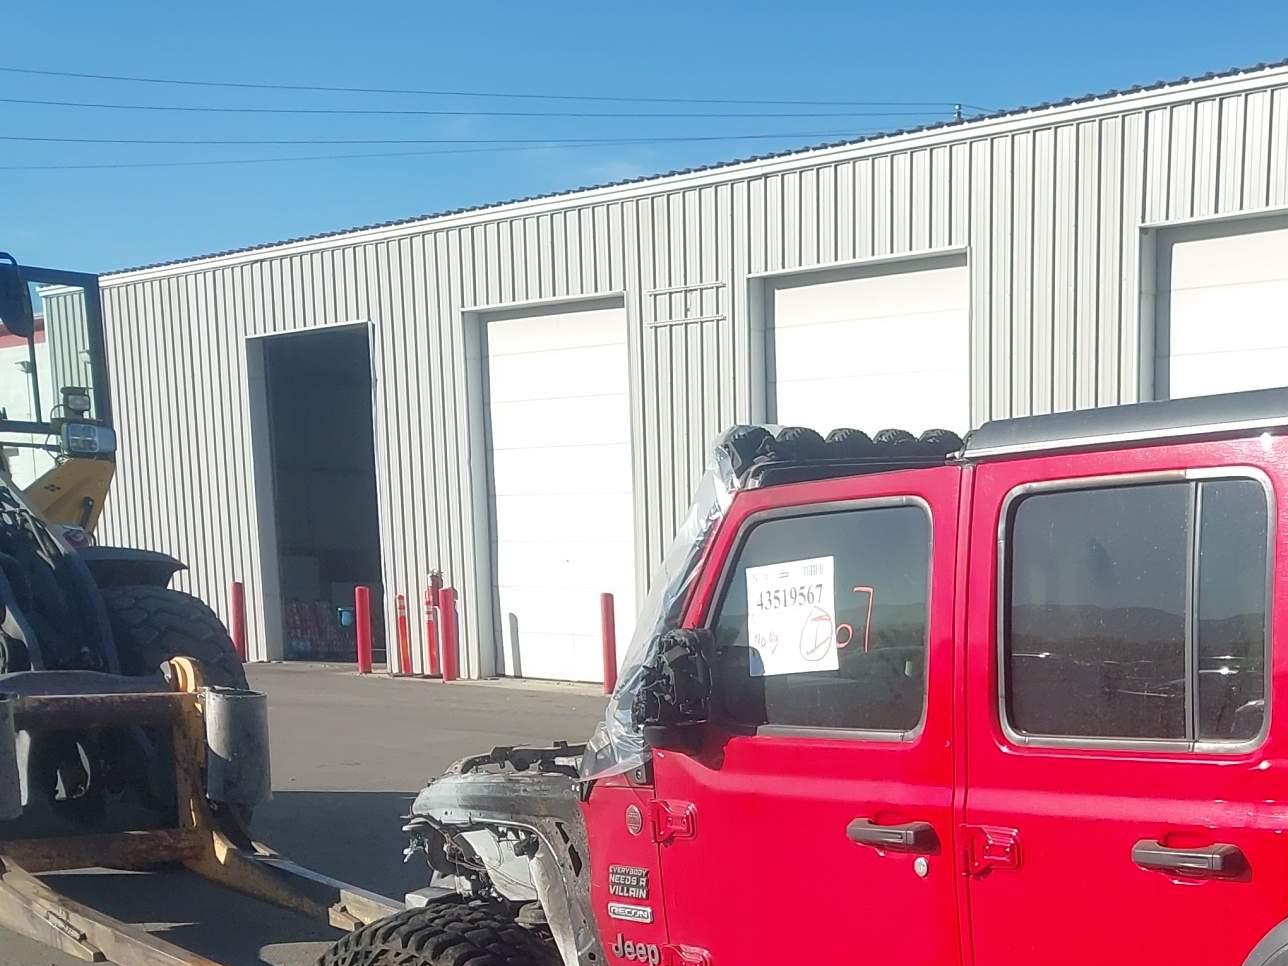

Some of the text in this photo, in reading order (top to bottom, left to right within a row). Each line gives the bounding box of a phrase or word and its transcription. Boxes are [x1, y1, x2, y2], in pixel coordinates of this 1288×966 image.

[757, 584, 823, 611] 43519567
[609, 865, 647, 877] EVERYBODY
[610, 873, 647, 888] NEEDS A
[609, 884, 647, 899] VILLAIN
[610, 905, 649, 920] RECON
